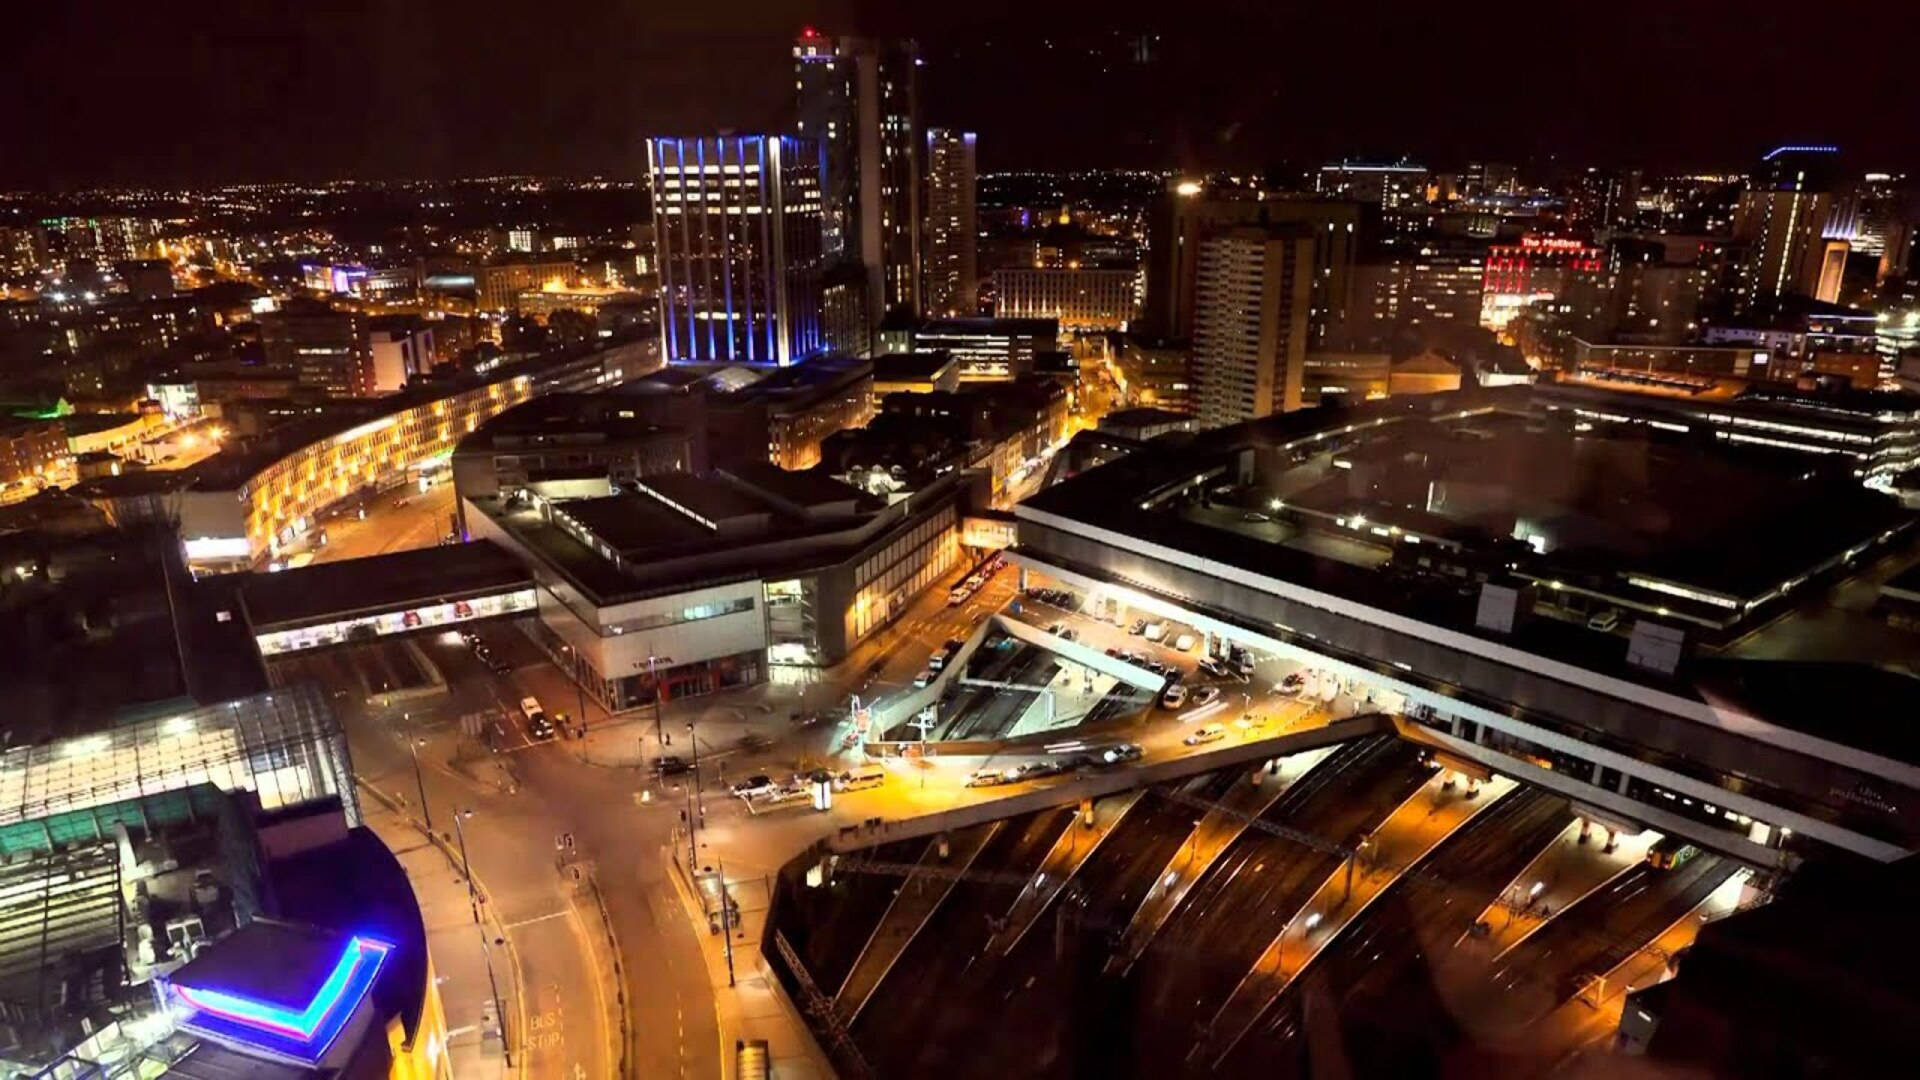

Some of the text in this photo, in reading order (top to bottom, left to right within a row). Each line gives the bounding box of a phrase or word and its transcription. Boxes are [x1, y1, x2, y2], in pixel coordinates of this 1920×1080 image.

[1522, 238, 1540, 247] The
[530, 1012, 555, 1030] BUS
[527, 1032, 560, 1050] STOP
